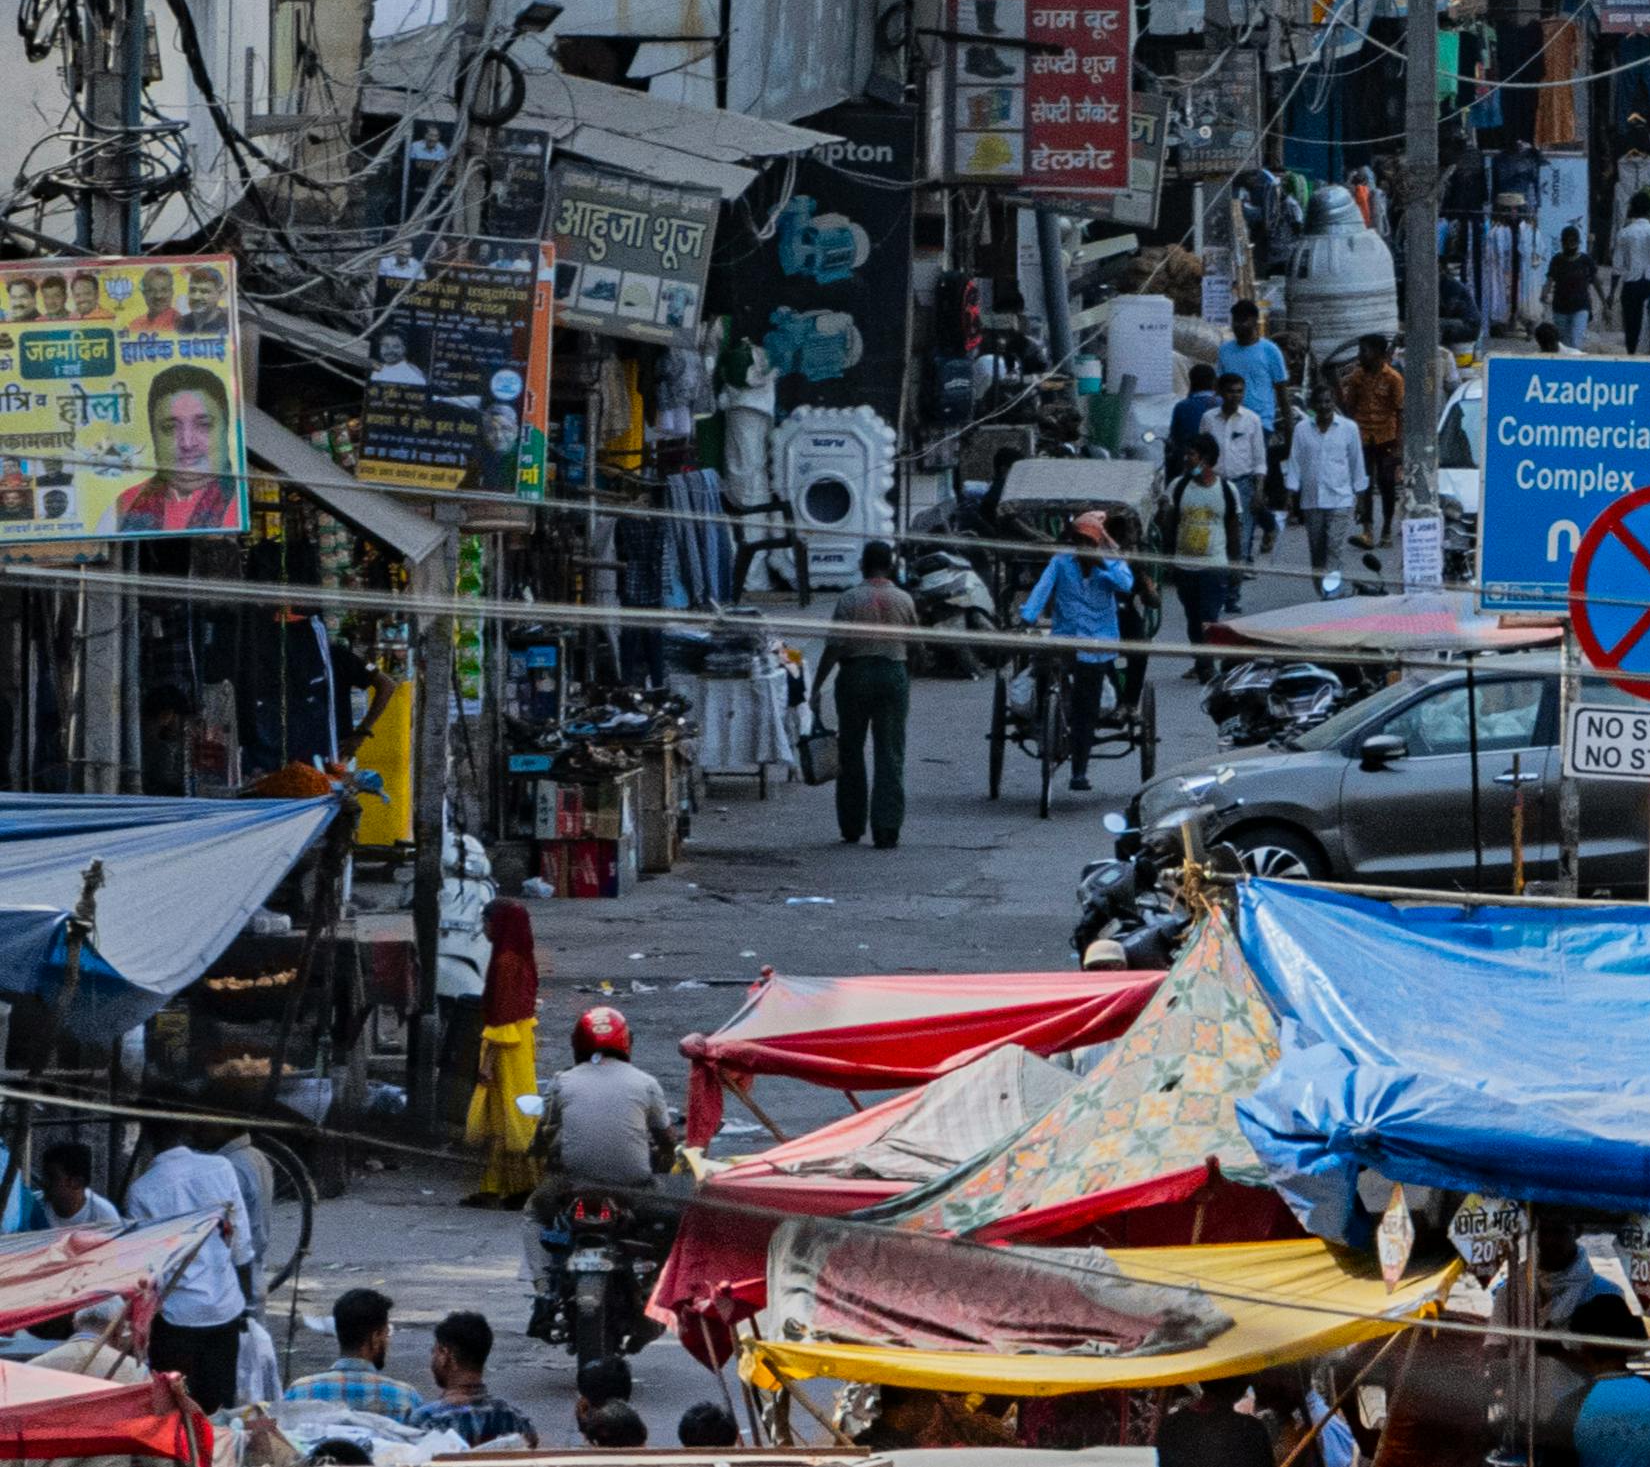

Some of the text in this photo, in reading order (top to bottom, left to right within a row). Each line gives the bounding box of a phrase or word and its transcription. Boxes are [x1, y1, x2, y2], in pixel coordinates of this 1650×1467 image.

[1032, 10, 1120, 41] गम बूट
[1082, 56, 1118, 86] शूज
[1031, 144, 1114, 172] हेलमेट
[555, 198, 708, 270] आहुजा शूज
[24, 332, 110, 364] जन्मदिन
[57, 381, 134, 426] होली
[1524, 374, 1639, 411] Azadpur
[1516, 458, 1636, 498] Complex
[1586, 716, 1625, 740] NO
[1585, 745, 1625, 770] NO
[1457, 1212, 1489, 1235] छोले
